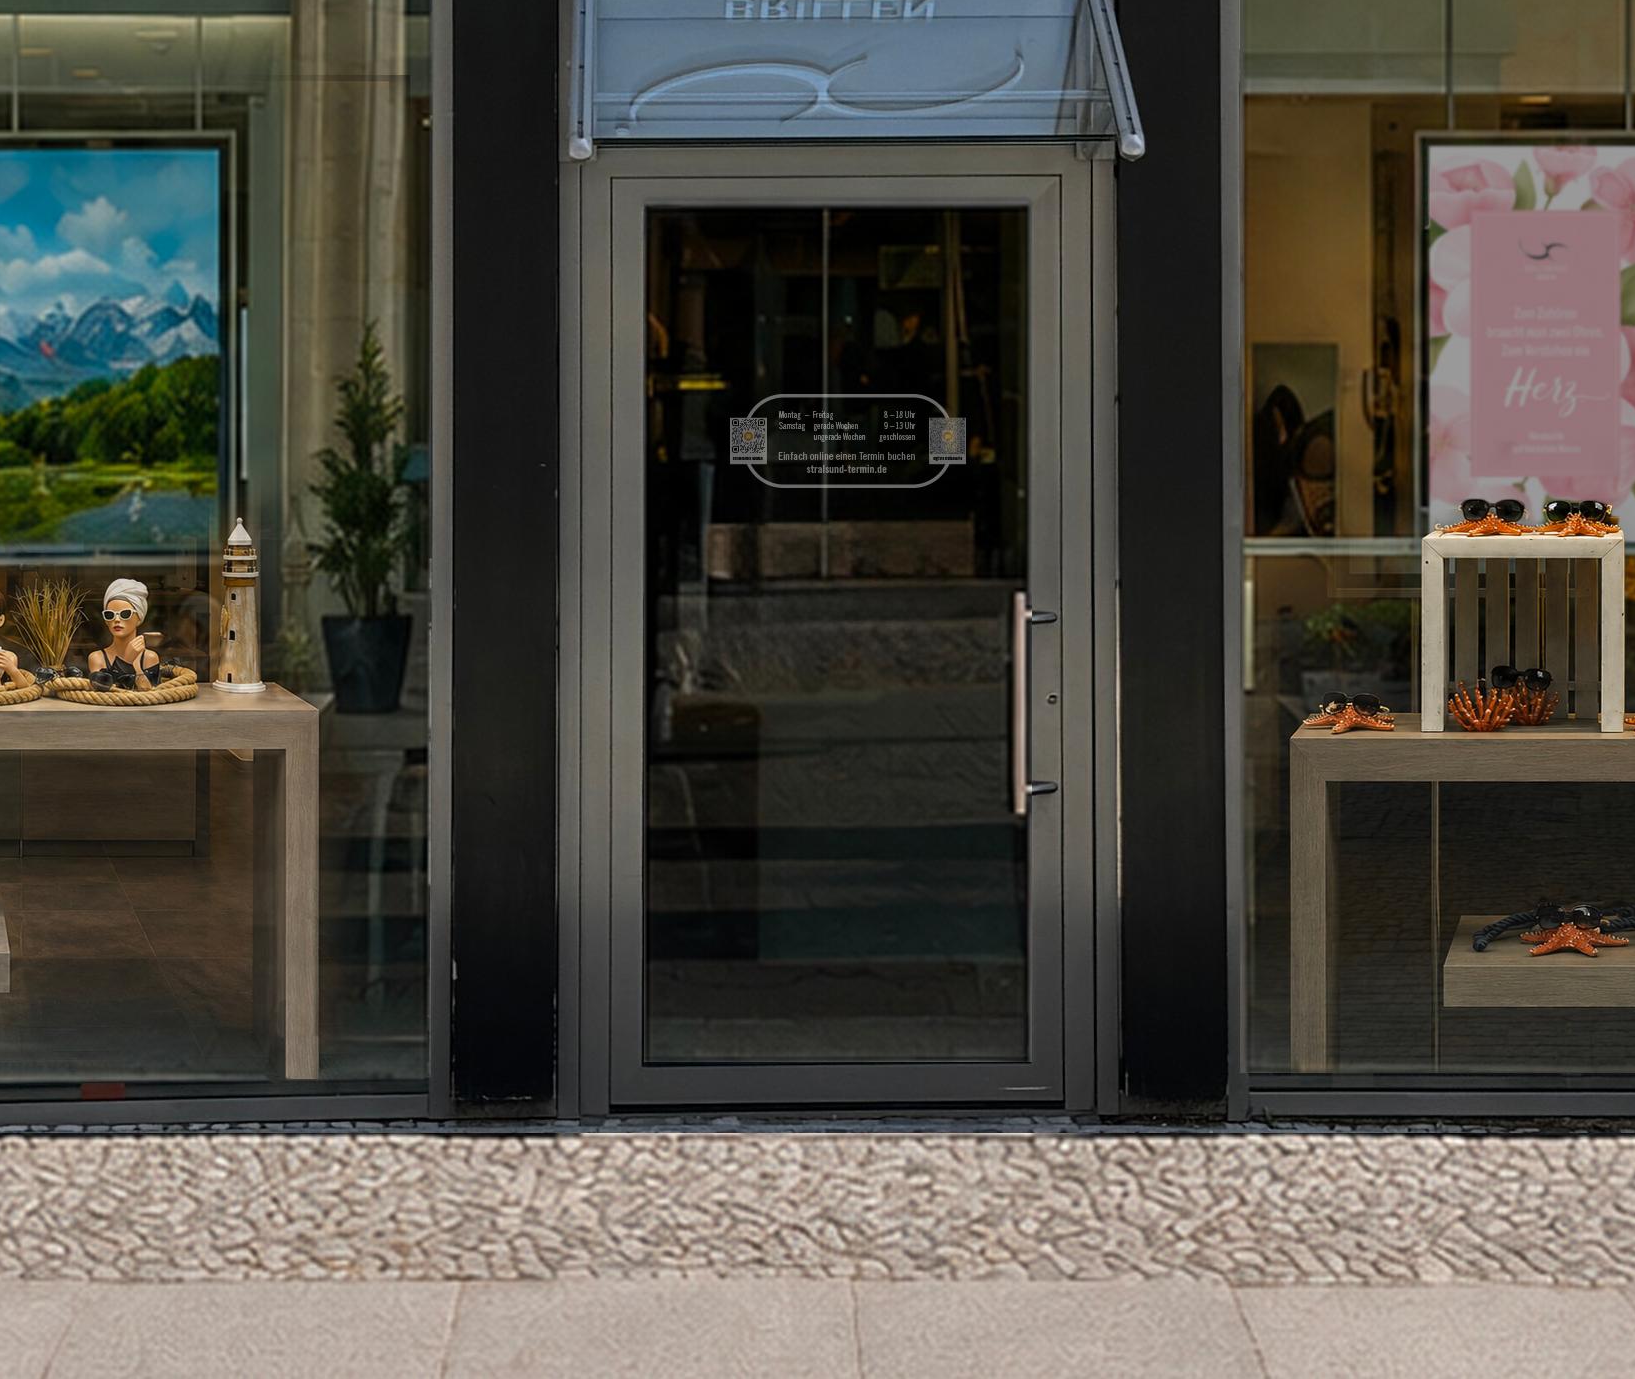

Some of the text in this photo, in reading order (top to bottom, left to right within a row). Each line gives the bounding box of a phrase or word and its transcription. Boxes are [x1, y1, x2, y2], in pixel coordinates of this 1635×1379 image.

[1505, 366, 1611, 418] Herz
[778, 410, 801, 421] Montag
[812, 410, 834, 421] Freitag
[904, 410, 916, 419] Uhr
[778, 421, 806, 432] Samstag
[813, 421, 835, 432] gerade
[835, 421, 859, 430] Wochen
[904, 421, 916, 430] Uhr
[813, 432, 916, 443] ungerade Wochen geschlossen
[778, 451, 916, 461] Einfach online einen Termin buchen
[806, 464, 888, 474] stralsund-termin.de
